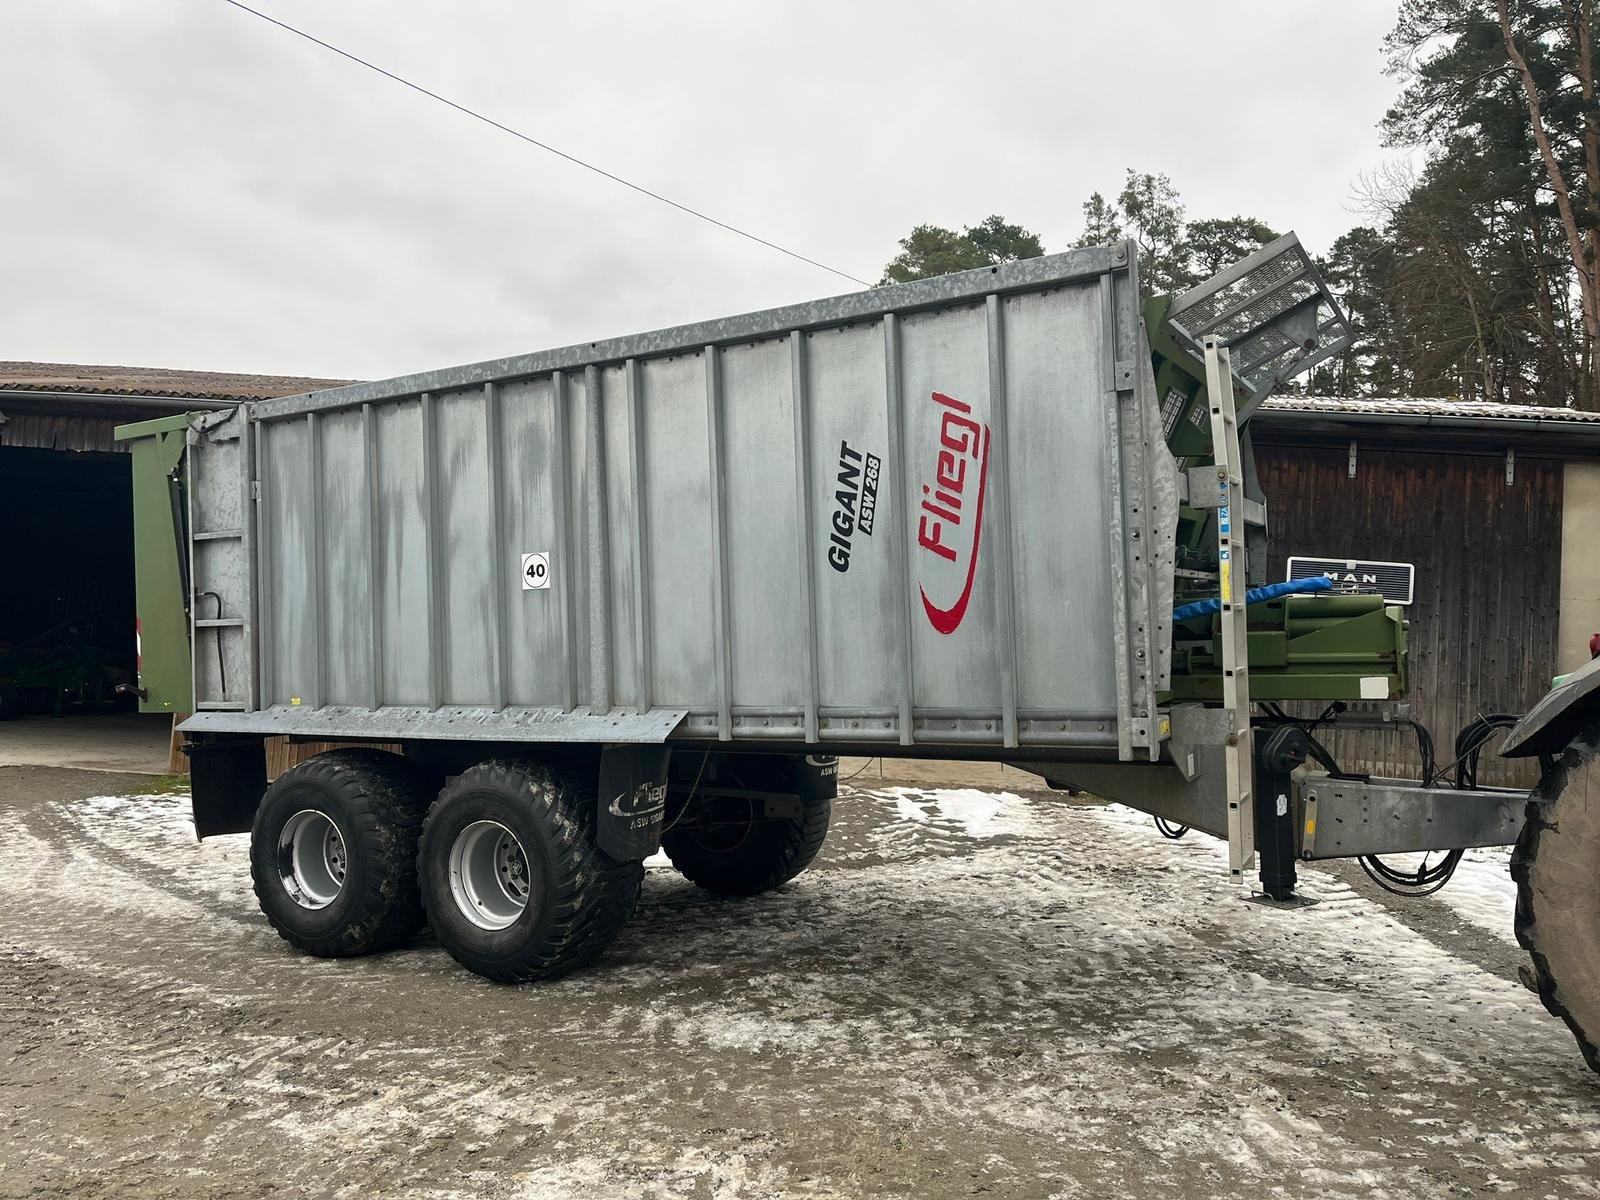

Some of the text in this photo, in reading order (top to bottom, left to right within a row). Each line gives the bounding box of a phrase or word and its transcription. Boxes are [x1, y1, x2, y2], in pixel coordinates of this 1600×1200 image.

[828, 439, 863, 573] GIGANT
[860, 456, 880, 533] ASW 268
[918, 391, 981, 562] Fliegl
[526, 564, 545, 578] 40
[1323, 571, 1377, 584] MAN
